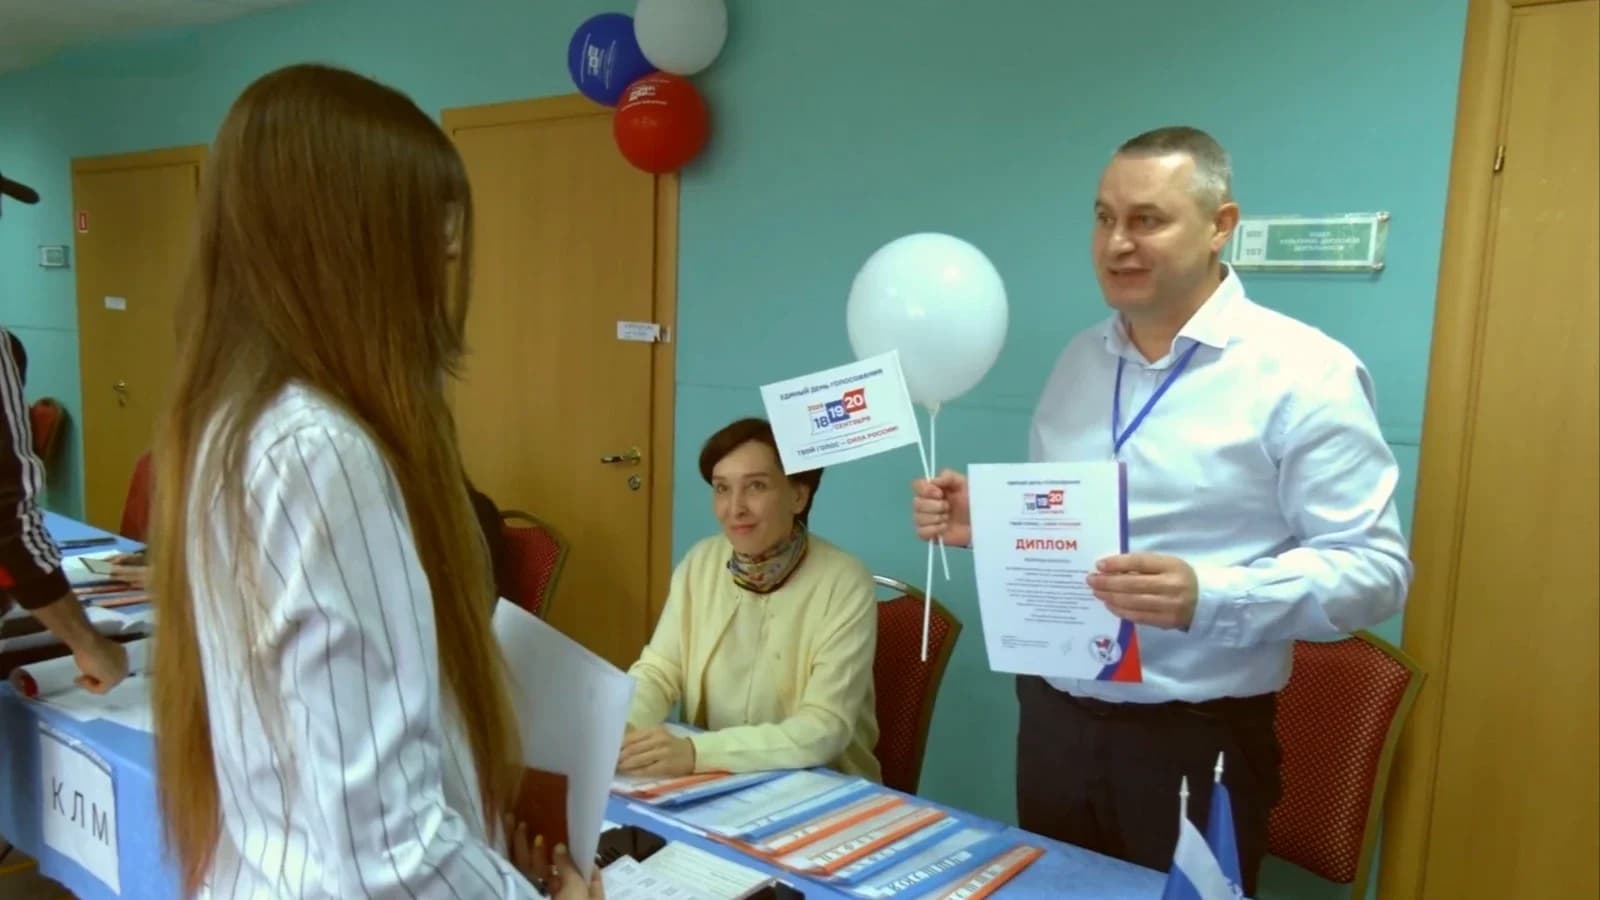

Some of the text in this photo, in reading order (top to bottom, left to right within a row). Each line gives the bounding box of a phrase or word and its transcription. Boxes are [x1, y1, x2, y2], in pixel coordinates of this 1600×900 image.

[811, 384, 830, 394] ДЕНЬ
[814, 394, 863, 429] 18 19 20
[1049, 494, 1063, 502] 20
[1015, 538, 1078, 551] ДИПЛОМ
